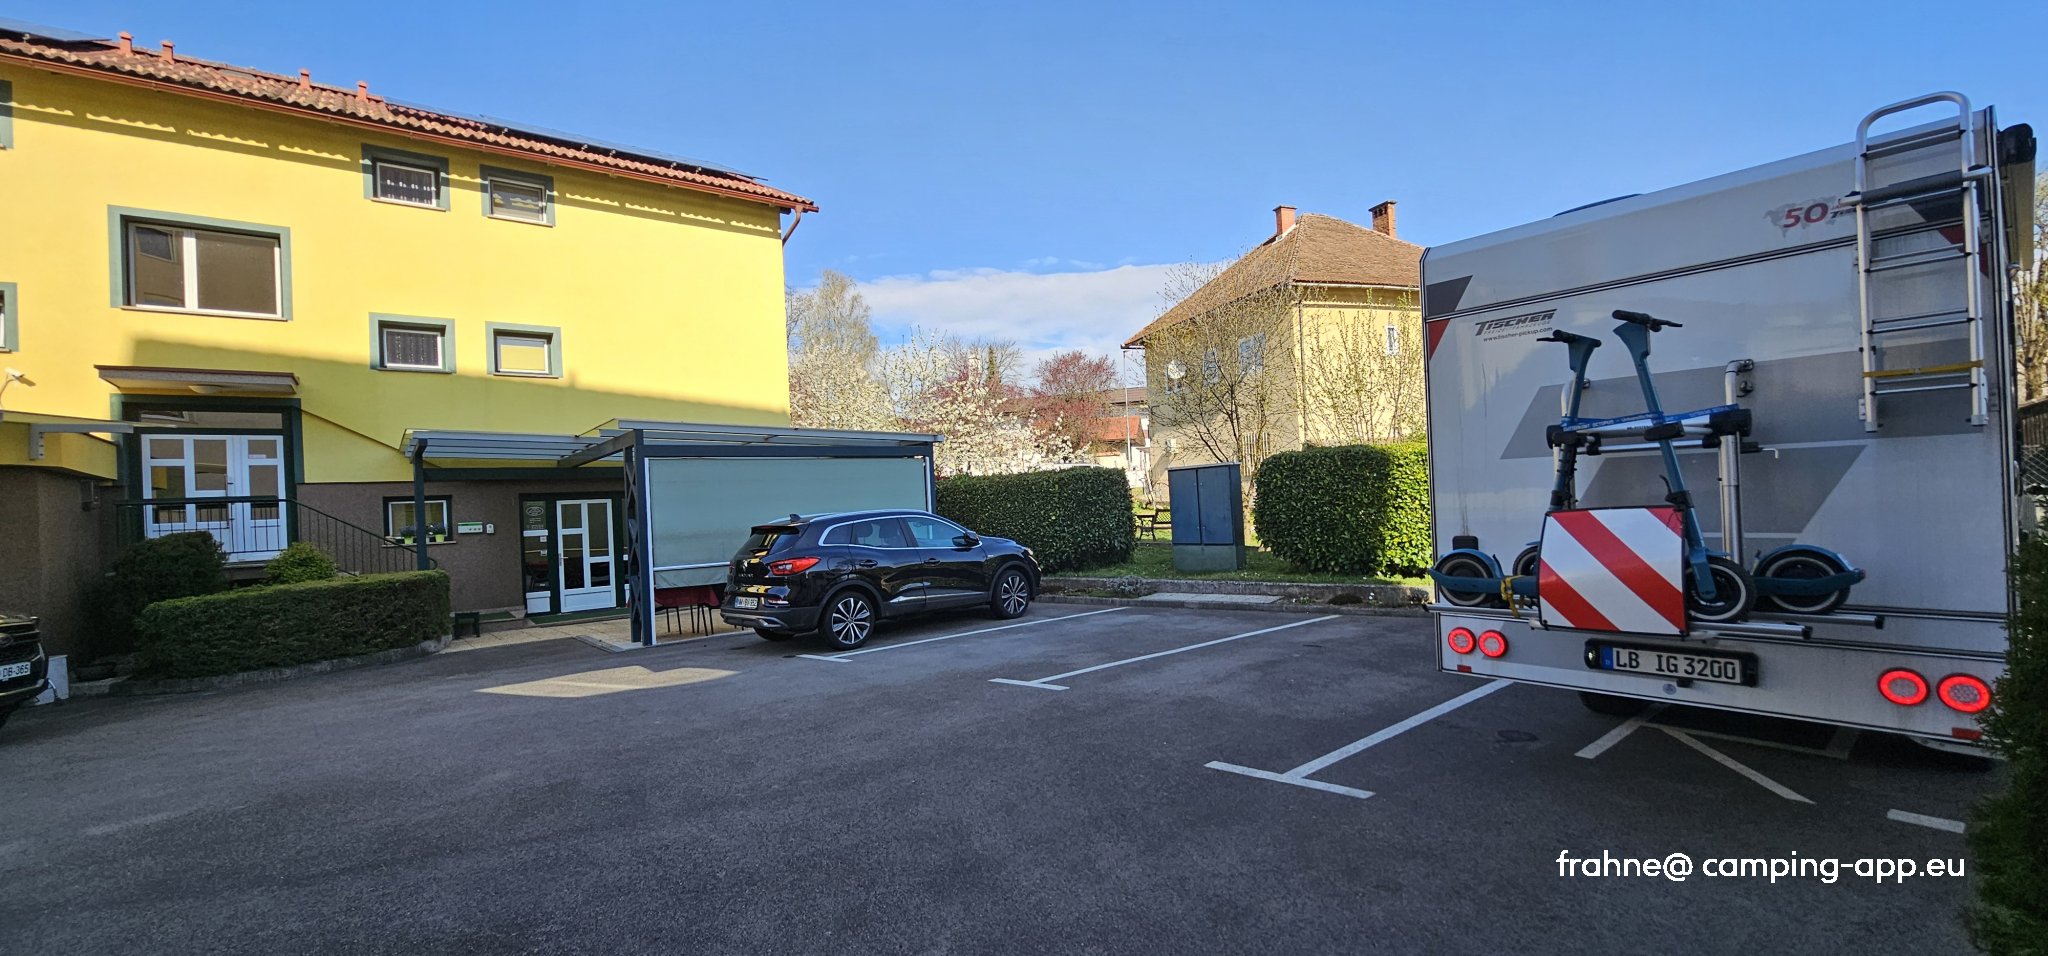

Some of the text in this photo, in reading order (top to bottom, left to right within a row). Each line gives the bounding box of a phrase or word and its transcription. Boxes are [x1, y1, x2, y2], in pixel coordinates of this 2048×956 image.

[1782, 202, 1829, 228] 50
[1483, 326, 1553, 342] www.tischer-pickup.com
[2, 664, 29, 677] DB-365
[1616, 650, 1736, 680] LB IG 3200
